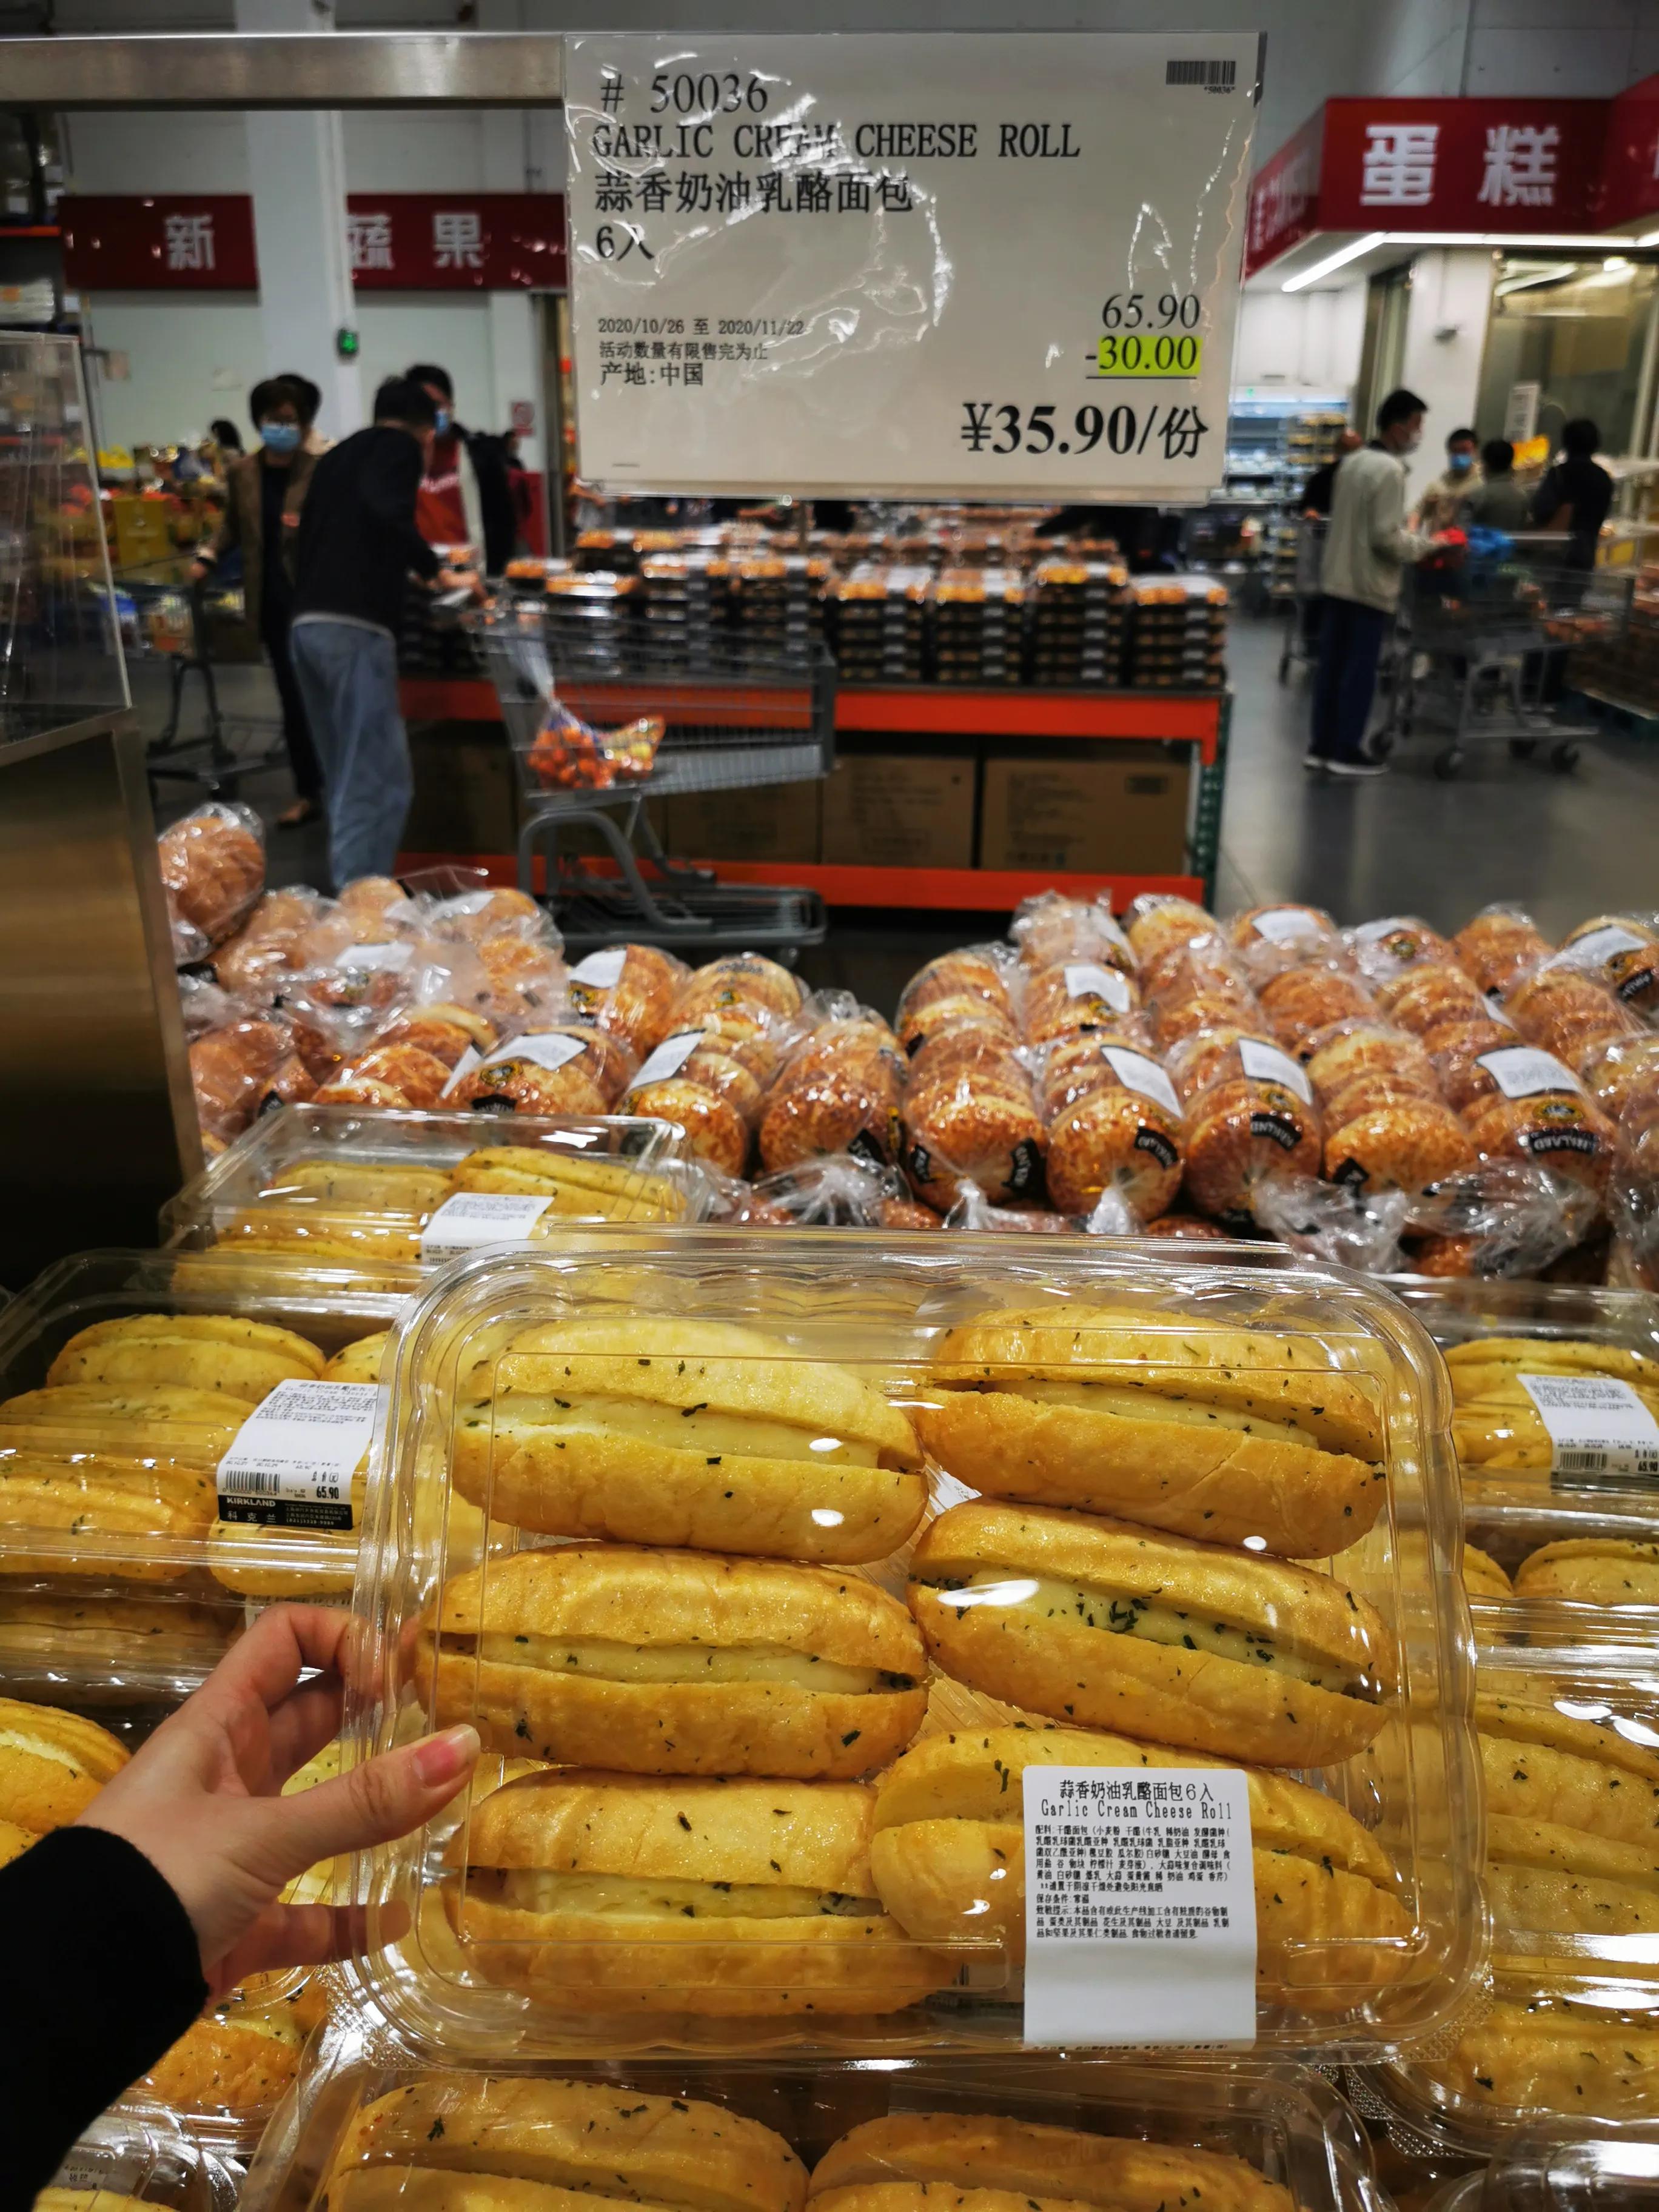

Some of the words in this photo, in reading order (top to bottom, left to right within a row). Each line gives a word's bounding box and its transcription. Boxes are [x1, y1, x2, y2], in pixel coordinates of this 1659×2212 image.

[600, 74, 625, 113] #
[651, 74, 768, 113] 50036
[592, 125, 714, 158] GARLIC
[856, 124, 977, 158] CHEESE
[998, 124, 1081, 158] ROLL
[1359, 124, 1560, 207] 蛋糕
[595, 171, 913, 213] 蒜香奶油乳酪面包
[1102, 294, 1201, 329] 65.90
[598, 318, 685, 335] 2020/10/26
[693, 318, 709, 335] 至
[718, 320, 805, 335] 2020/11/22
[599, 341, 768, 361] 活动数量有限售完为止
[1085, 335, 1197, 370] -30.00
[600, 362, 704, 386] 产地:中国
[960, 402, 1209, 460] ¥35.90/份
[227, 1496, 276, 1507] KIRKLAND
[317, 1486, 340, 1500] 65.90
[227, 1510, 277, 1524] 科克兰
[1059, 1780, 1213, 1801] 蒜香奶油乳酪面包6入
[1041, 1799, 1088, 1817] Garlic
[1098, 1800, 1138, 1818] Cream
[1145, 1800, 1192, 1818] Cheese
[1201, 1801, 1231, 1819] Roll
